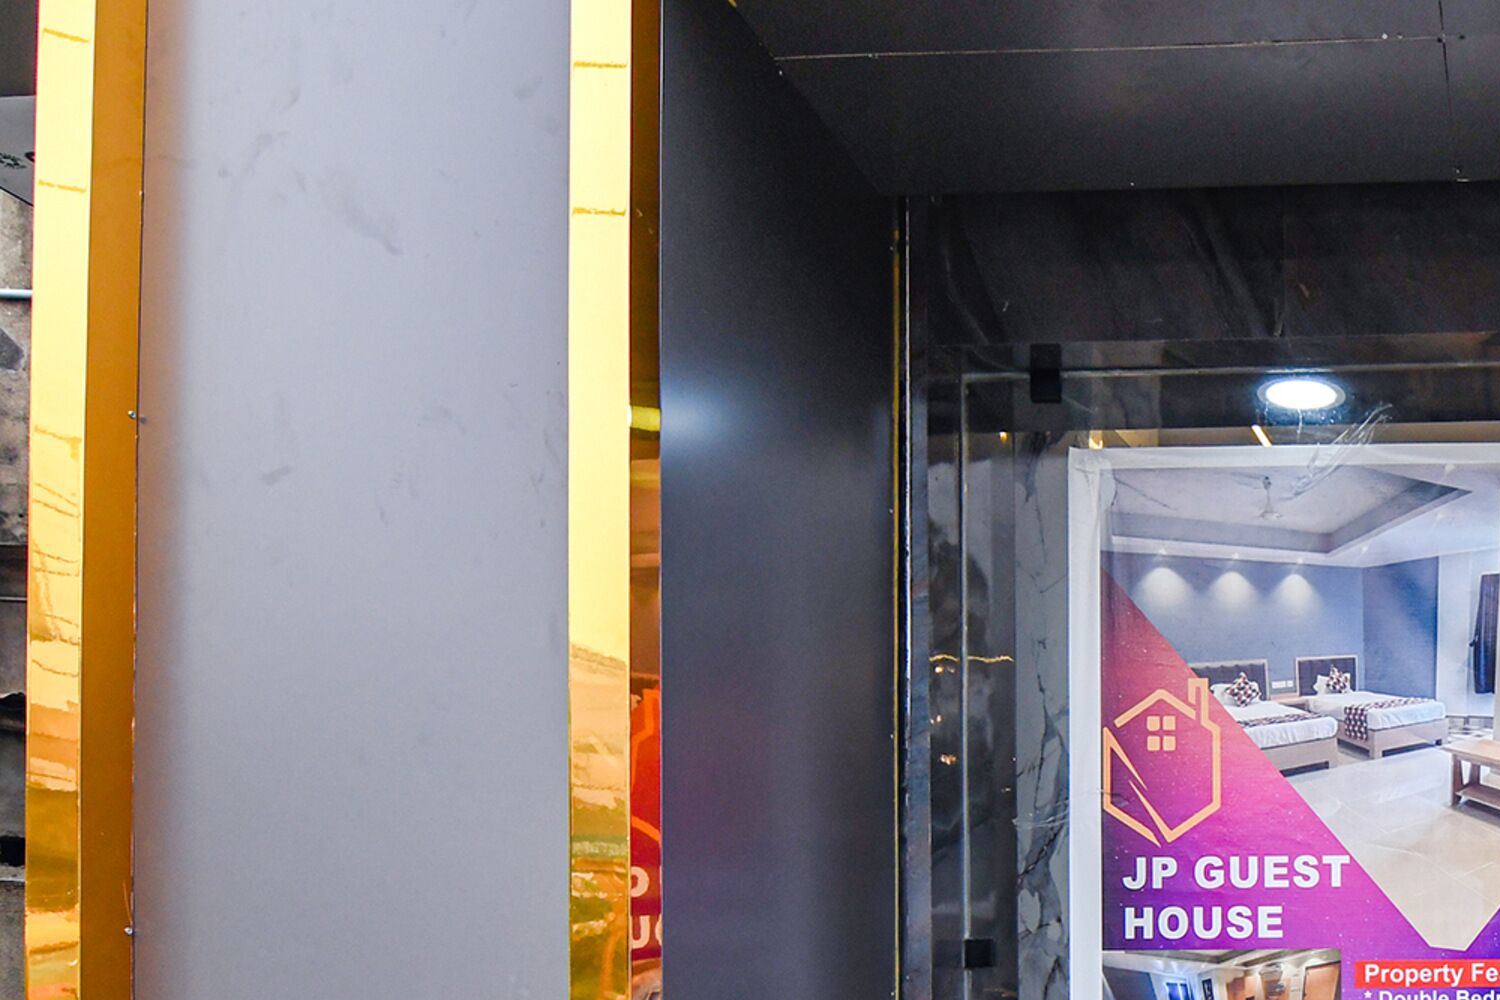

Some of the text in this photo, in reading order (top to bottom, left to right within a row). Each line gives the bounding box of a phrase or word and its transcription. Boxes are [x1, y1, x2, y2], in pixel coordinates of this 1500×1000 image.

[1122, 855, 1350, 890] JP GUEST
[1124, 906, 1284, 940] HOUSE
[1364, 964, 1464, 987] Property
